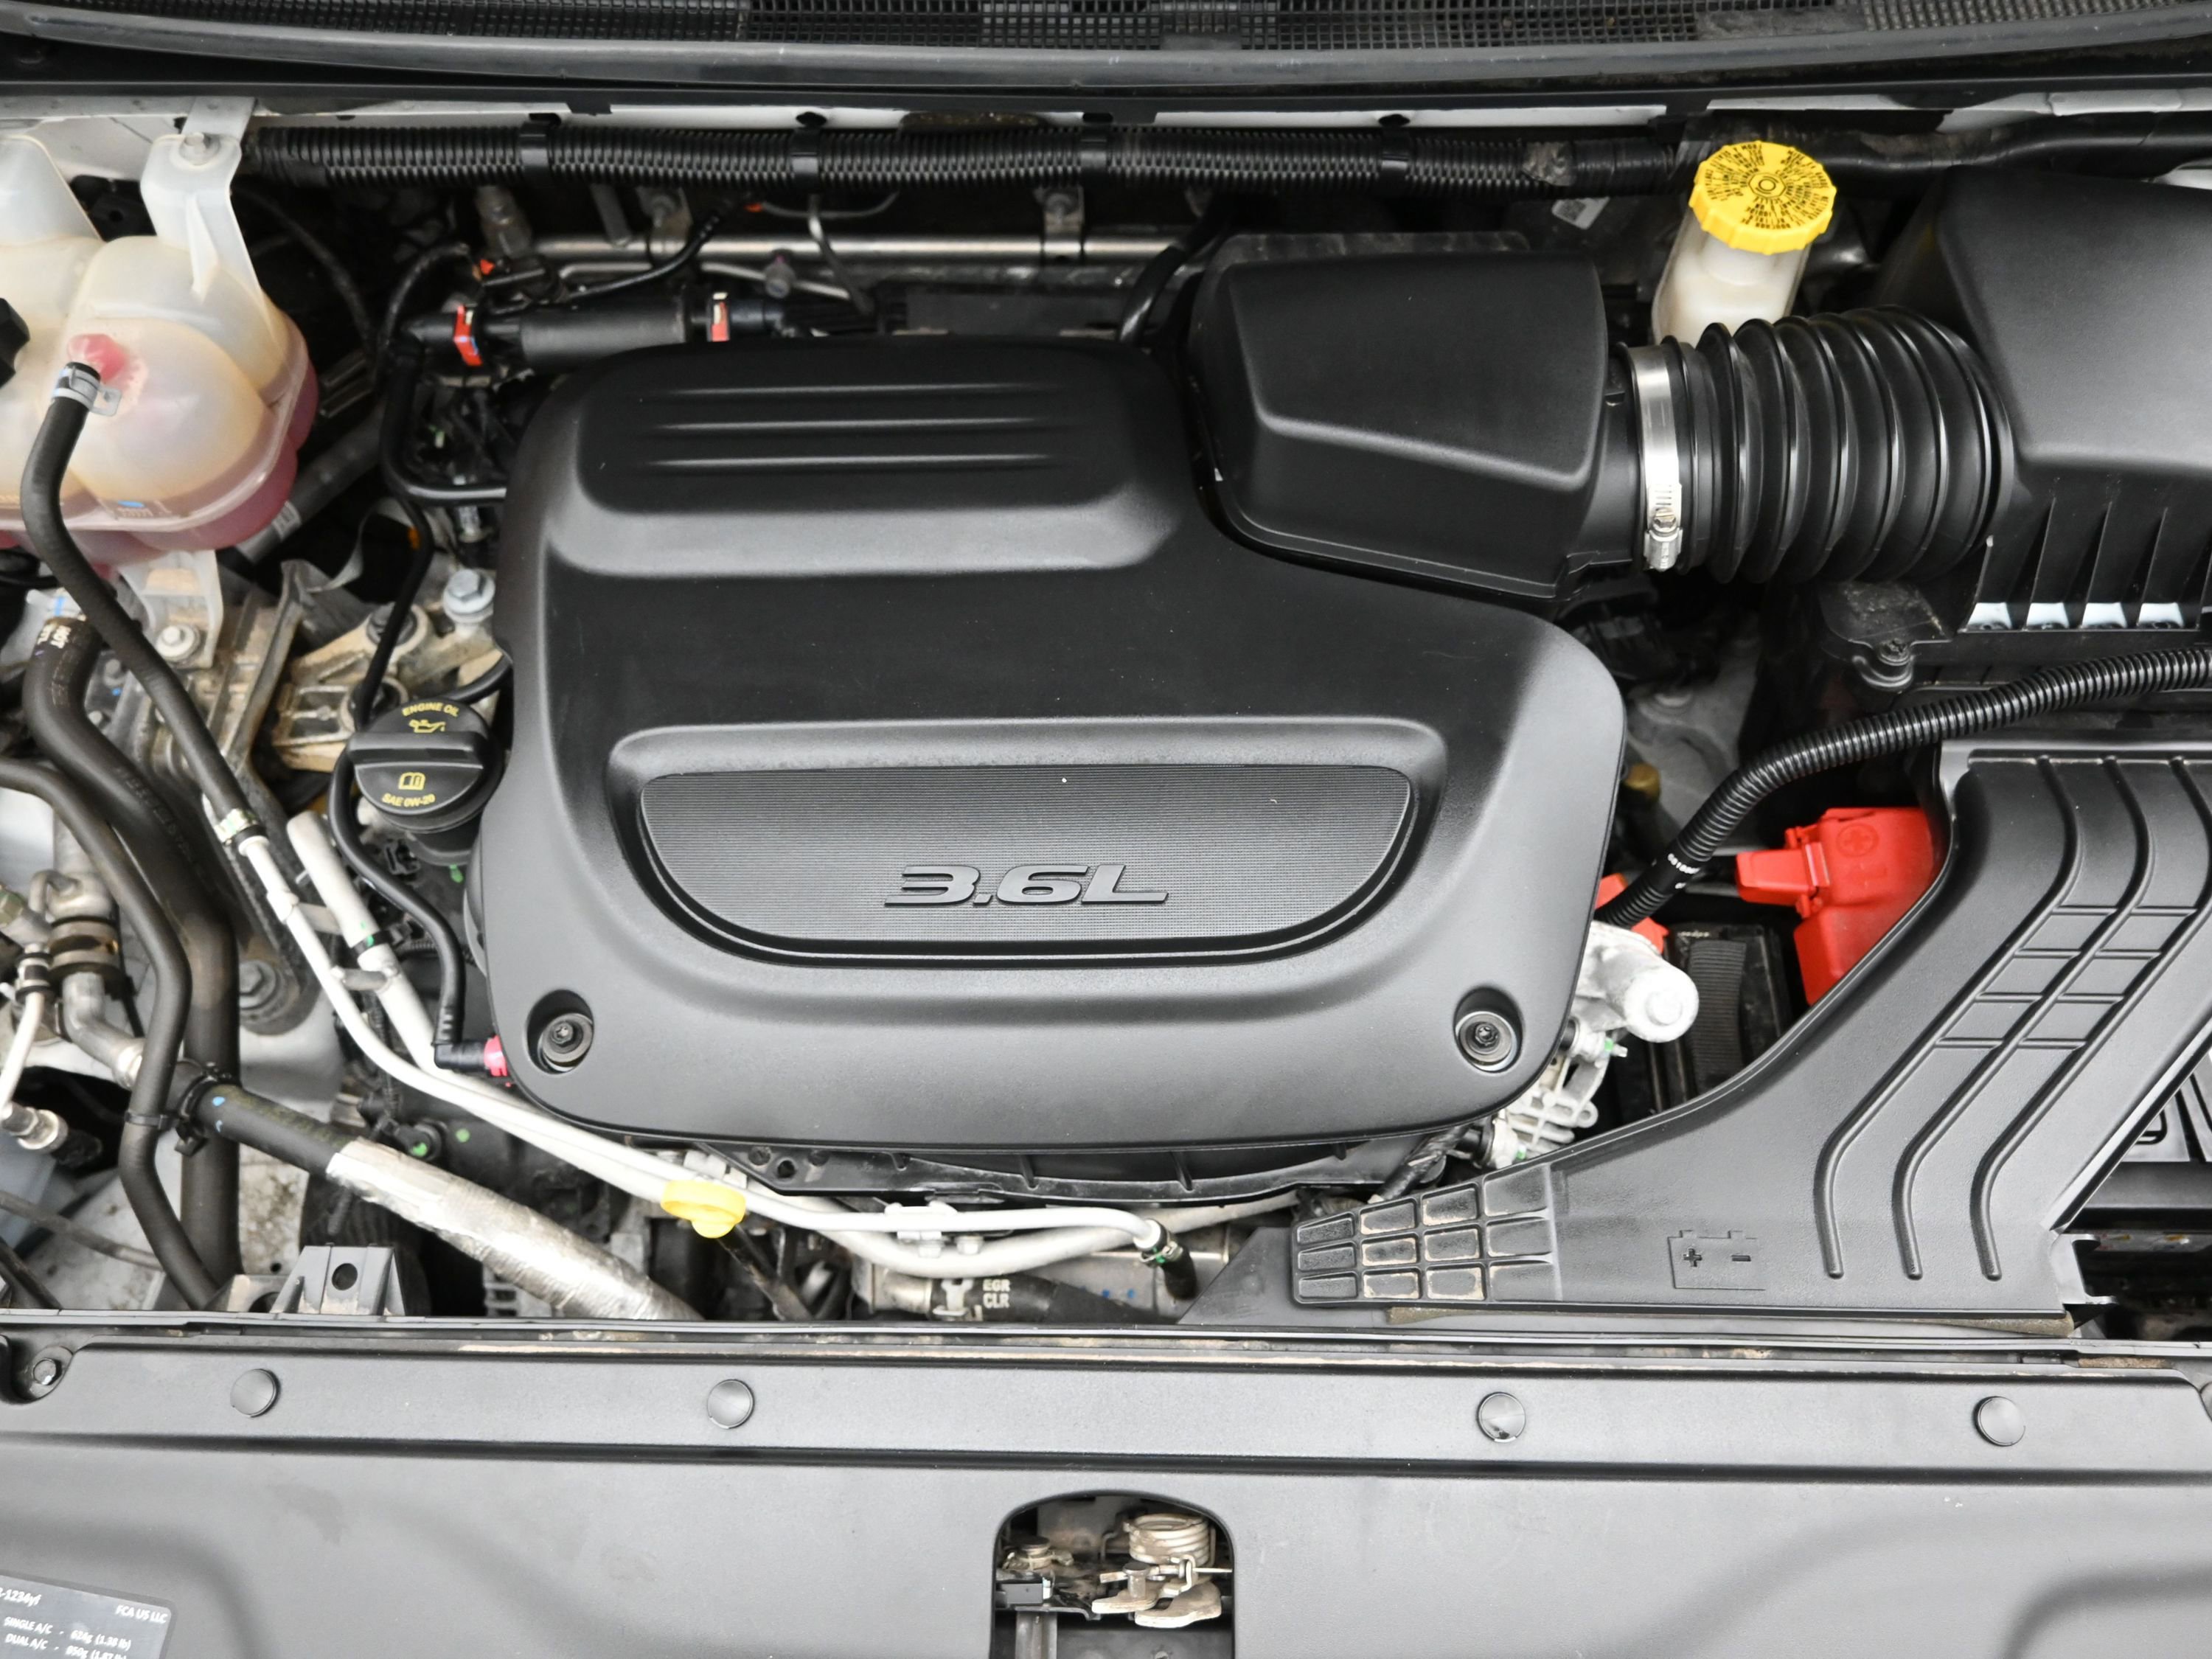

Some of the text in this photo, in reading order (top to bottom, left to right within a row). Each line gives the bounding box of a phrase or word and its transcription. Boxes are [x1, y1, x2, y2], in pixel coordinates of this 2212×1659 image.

[402, 702, 459, 717] ENGINE OIL
[381, 793, 436, 807] SAE 0W-20
[884, 864, 1169, 906] 3.6L
[982, 1279, 1011, 1292] EGR
[982, 1293, 1010, 1308] CLR
[116, 1604, 168, 1624] FCA US LLC
[4, 1616, 35, 1631] SINGLE
[33, 1623, 53, 1635] A/C
[5, 1633, 29, 1646] DUAL
[29, 1638, 49, 1650] A/C
